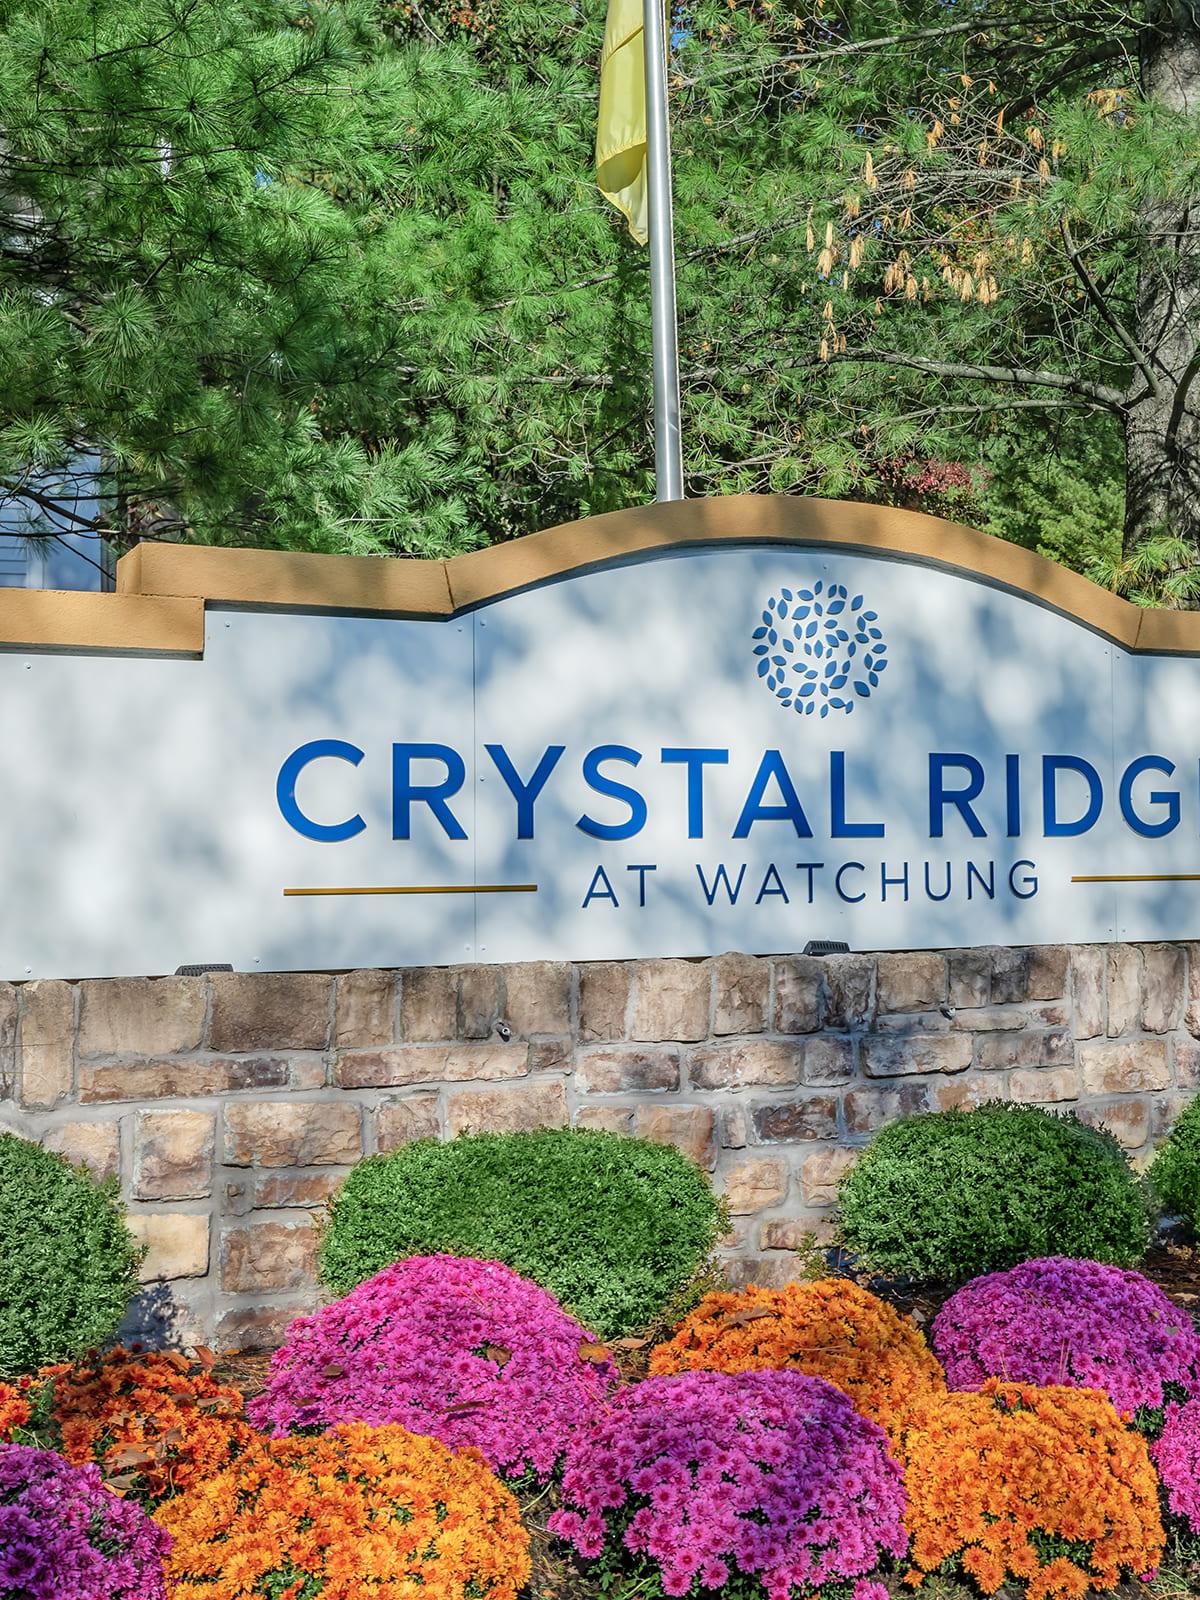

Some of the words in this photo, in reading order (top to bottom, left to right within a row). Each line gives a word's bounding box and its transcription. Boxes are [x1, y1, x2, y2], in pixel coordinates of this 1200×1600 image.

[276, 739, 885, 842] CRYSTAL
[581, 863, 657, 908] AT
[695, 859, 1039, 906] WATCHUNG
